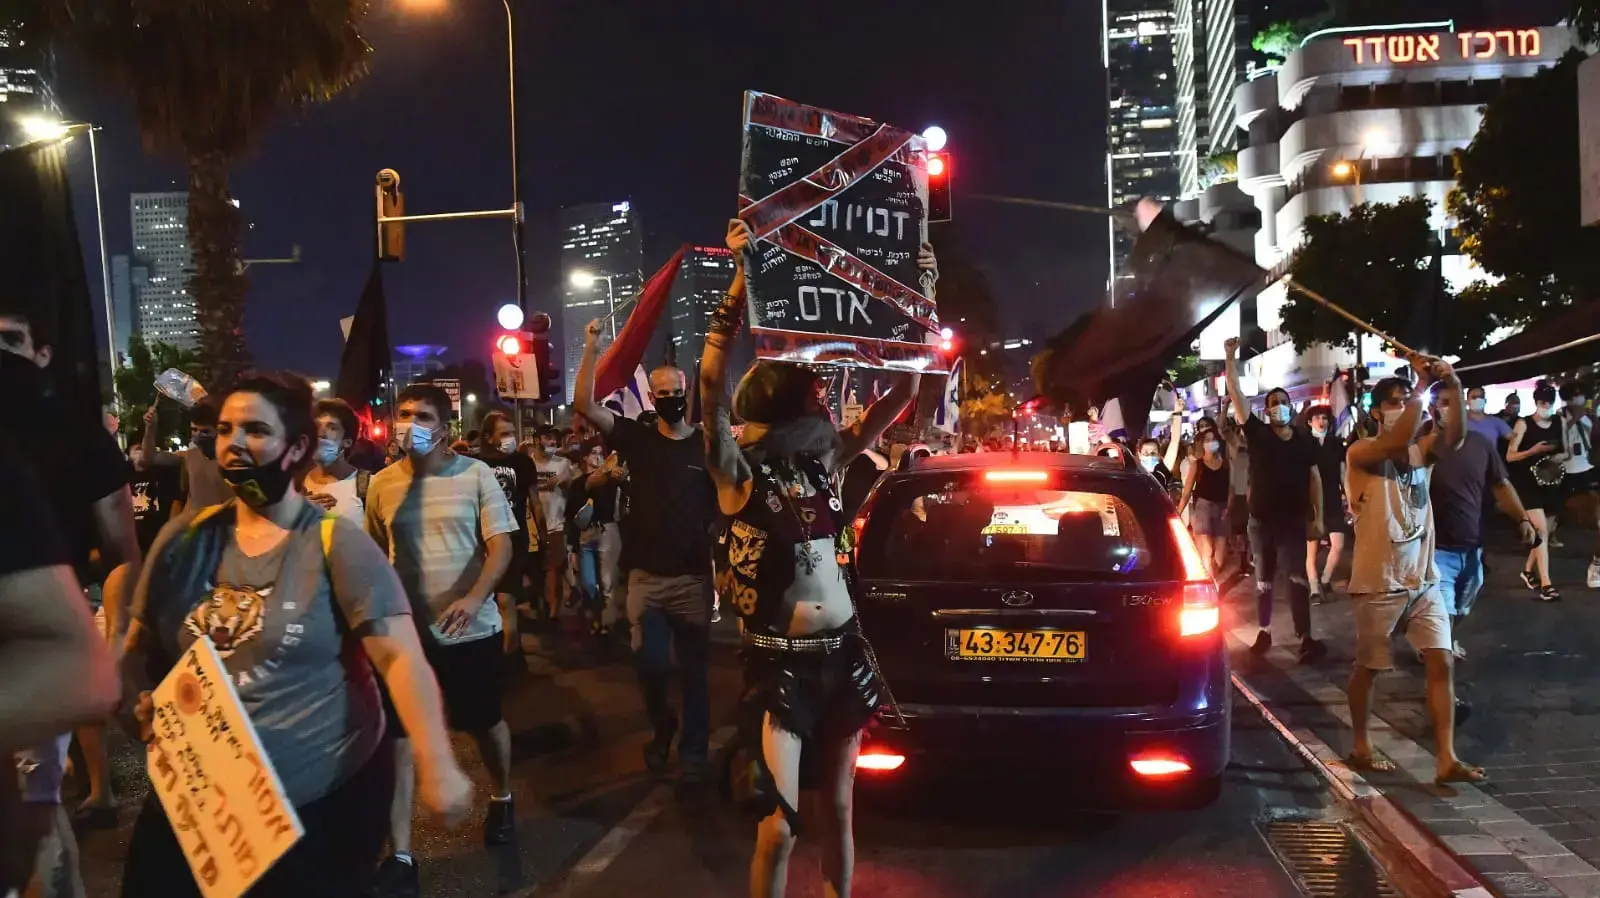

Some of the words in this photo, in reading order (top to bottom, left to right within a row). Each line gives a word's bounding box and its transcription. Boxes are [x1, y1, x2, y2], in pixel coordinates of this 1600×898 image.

[1343, 34, 1440, 64] אשדר
[1457, 28, 1541, 59] מרכז
[882, 167, 902, 178] חופש
[809, 199, 910, 241] זכויות
[887, 250, 910, 260] הזכות
[244, 751, 291, 841] אסור
